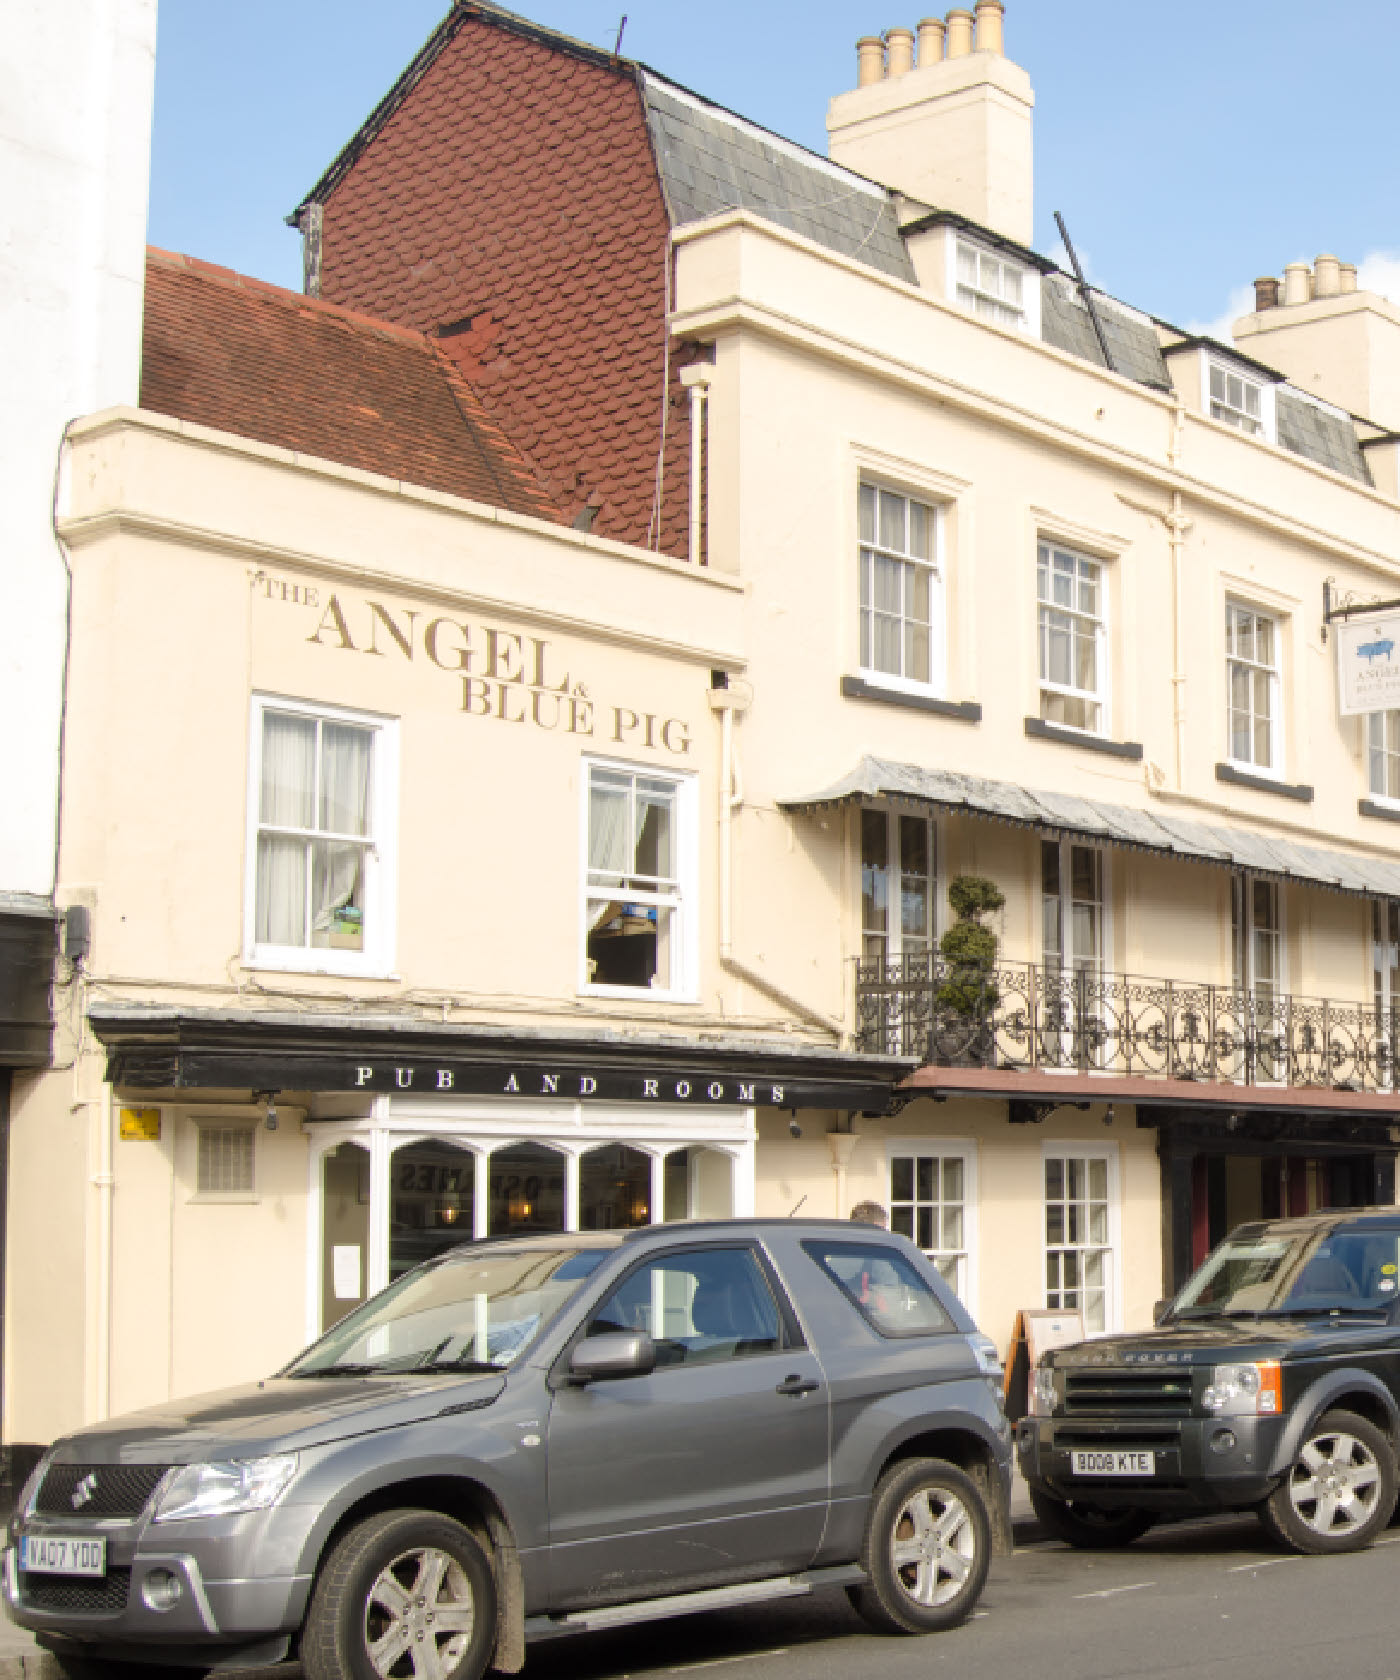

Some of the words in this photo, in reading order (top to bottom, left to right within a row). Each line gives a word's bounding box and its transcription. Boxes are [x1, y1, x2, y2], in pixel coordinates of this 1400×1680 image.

[264, 577, 319, 607] THE
[305, 593, 571, 692] ANGEL
[573, 681, 589, 698] &
[459, 674, 595, 736] BLUE
[610, 706, 693, 754] PIG
[355, 1066, 455, 1088] PUB
[503, 1072, 597, 1095] AND
[643, 1079, 785, 1103] ROOMS
[1118, 1453, 1149, 1472] KTE
